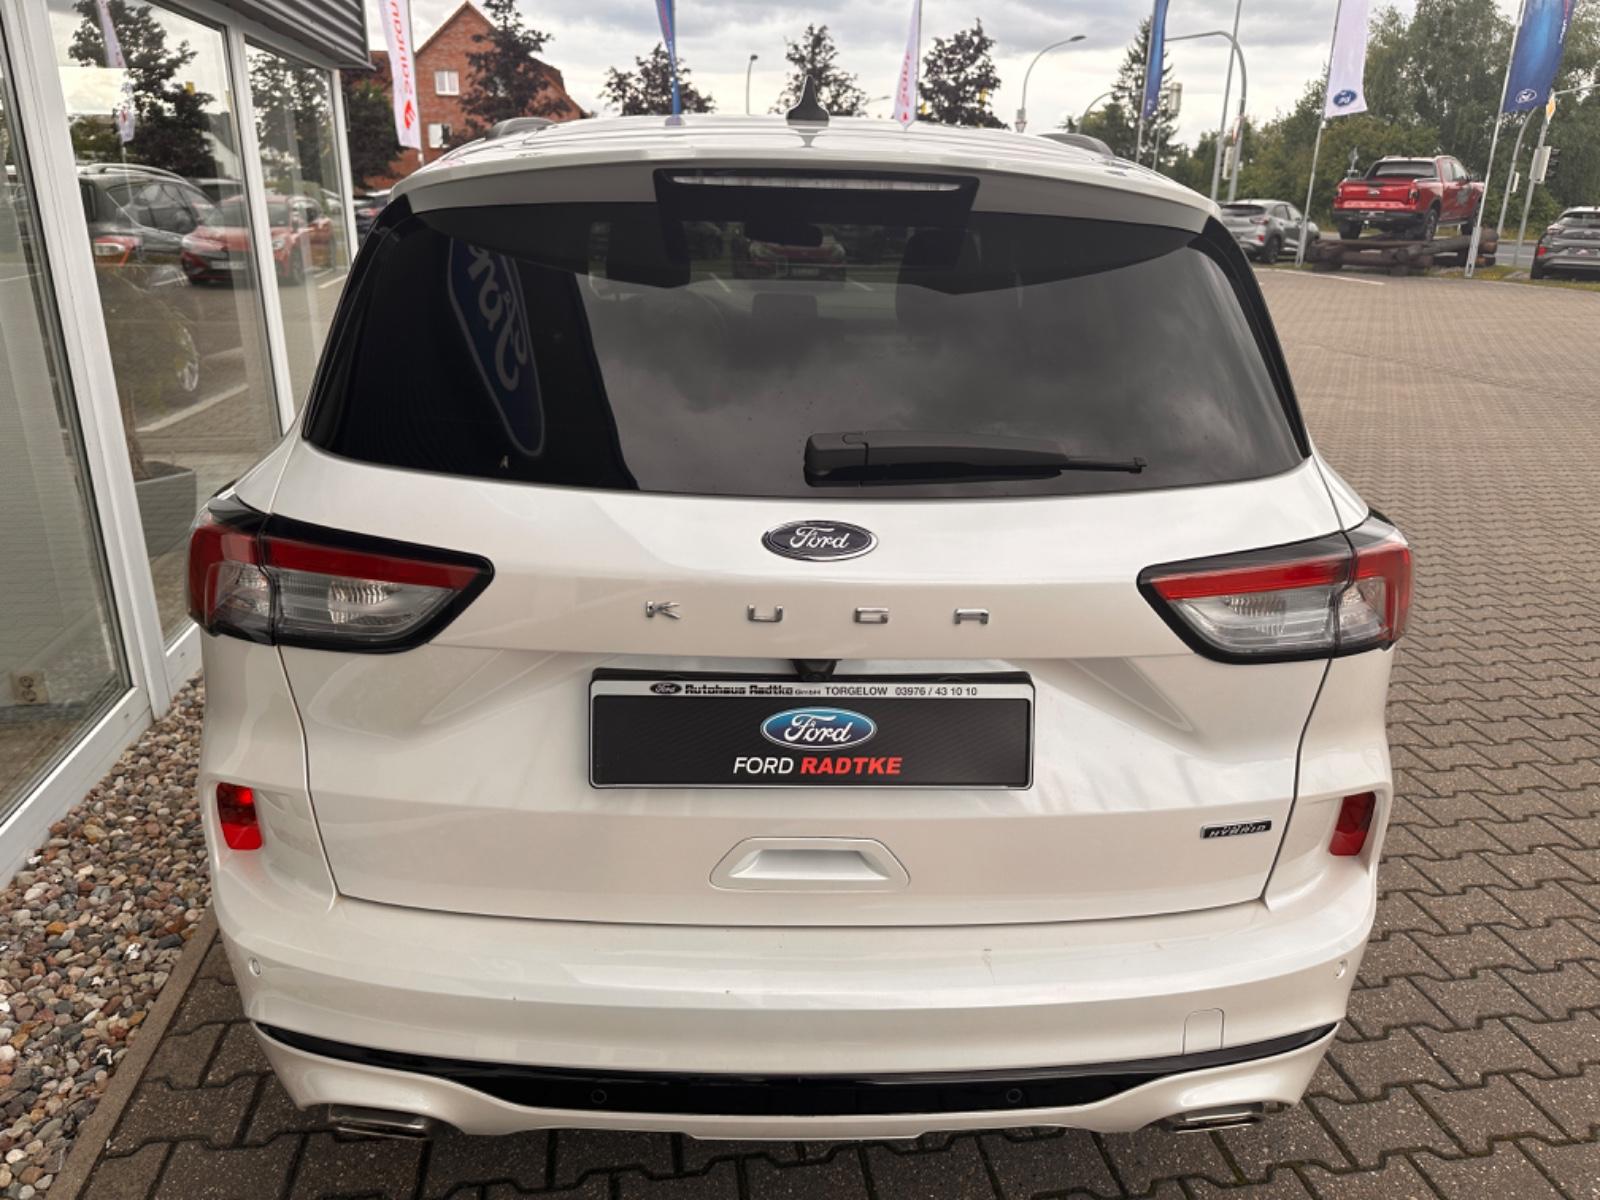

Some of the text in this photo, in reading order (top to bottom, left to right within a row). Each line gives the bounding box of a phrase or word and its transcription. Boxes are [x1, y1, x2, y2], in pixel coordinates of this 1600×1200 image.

[790, 526, 850, 548] Ford
[646, 600, 989, 625] KUGA
[685, 684, 746, 695] Autohaus
[750, 685, 793, 695] Radtke
[825, 686, 888, 696] TORGELOW
[895, 686, 926, 696] 03976
[935, 687, 948, 696] 43
[951, 687, 963, 696] 10
[966, 687, 978, 696] 10
[784, 713, 853, 742] Ford
[732, 756, 903, 774] FORD RADTKE
